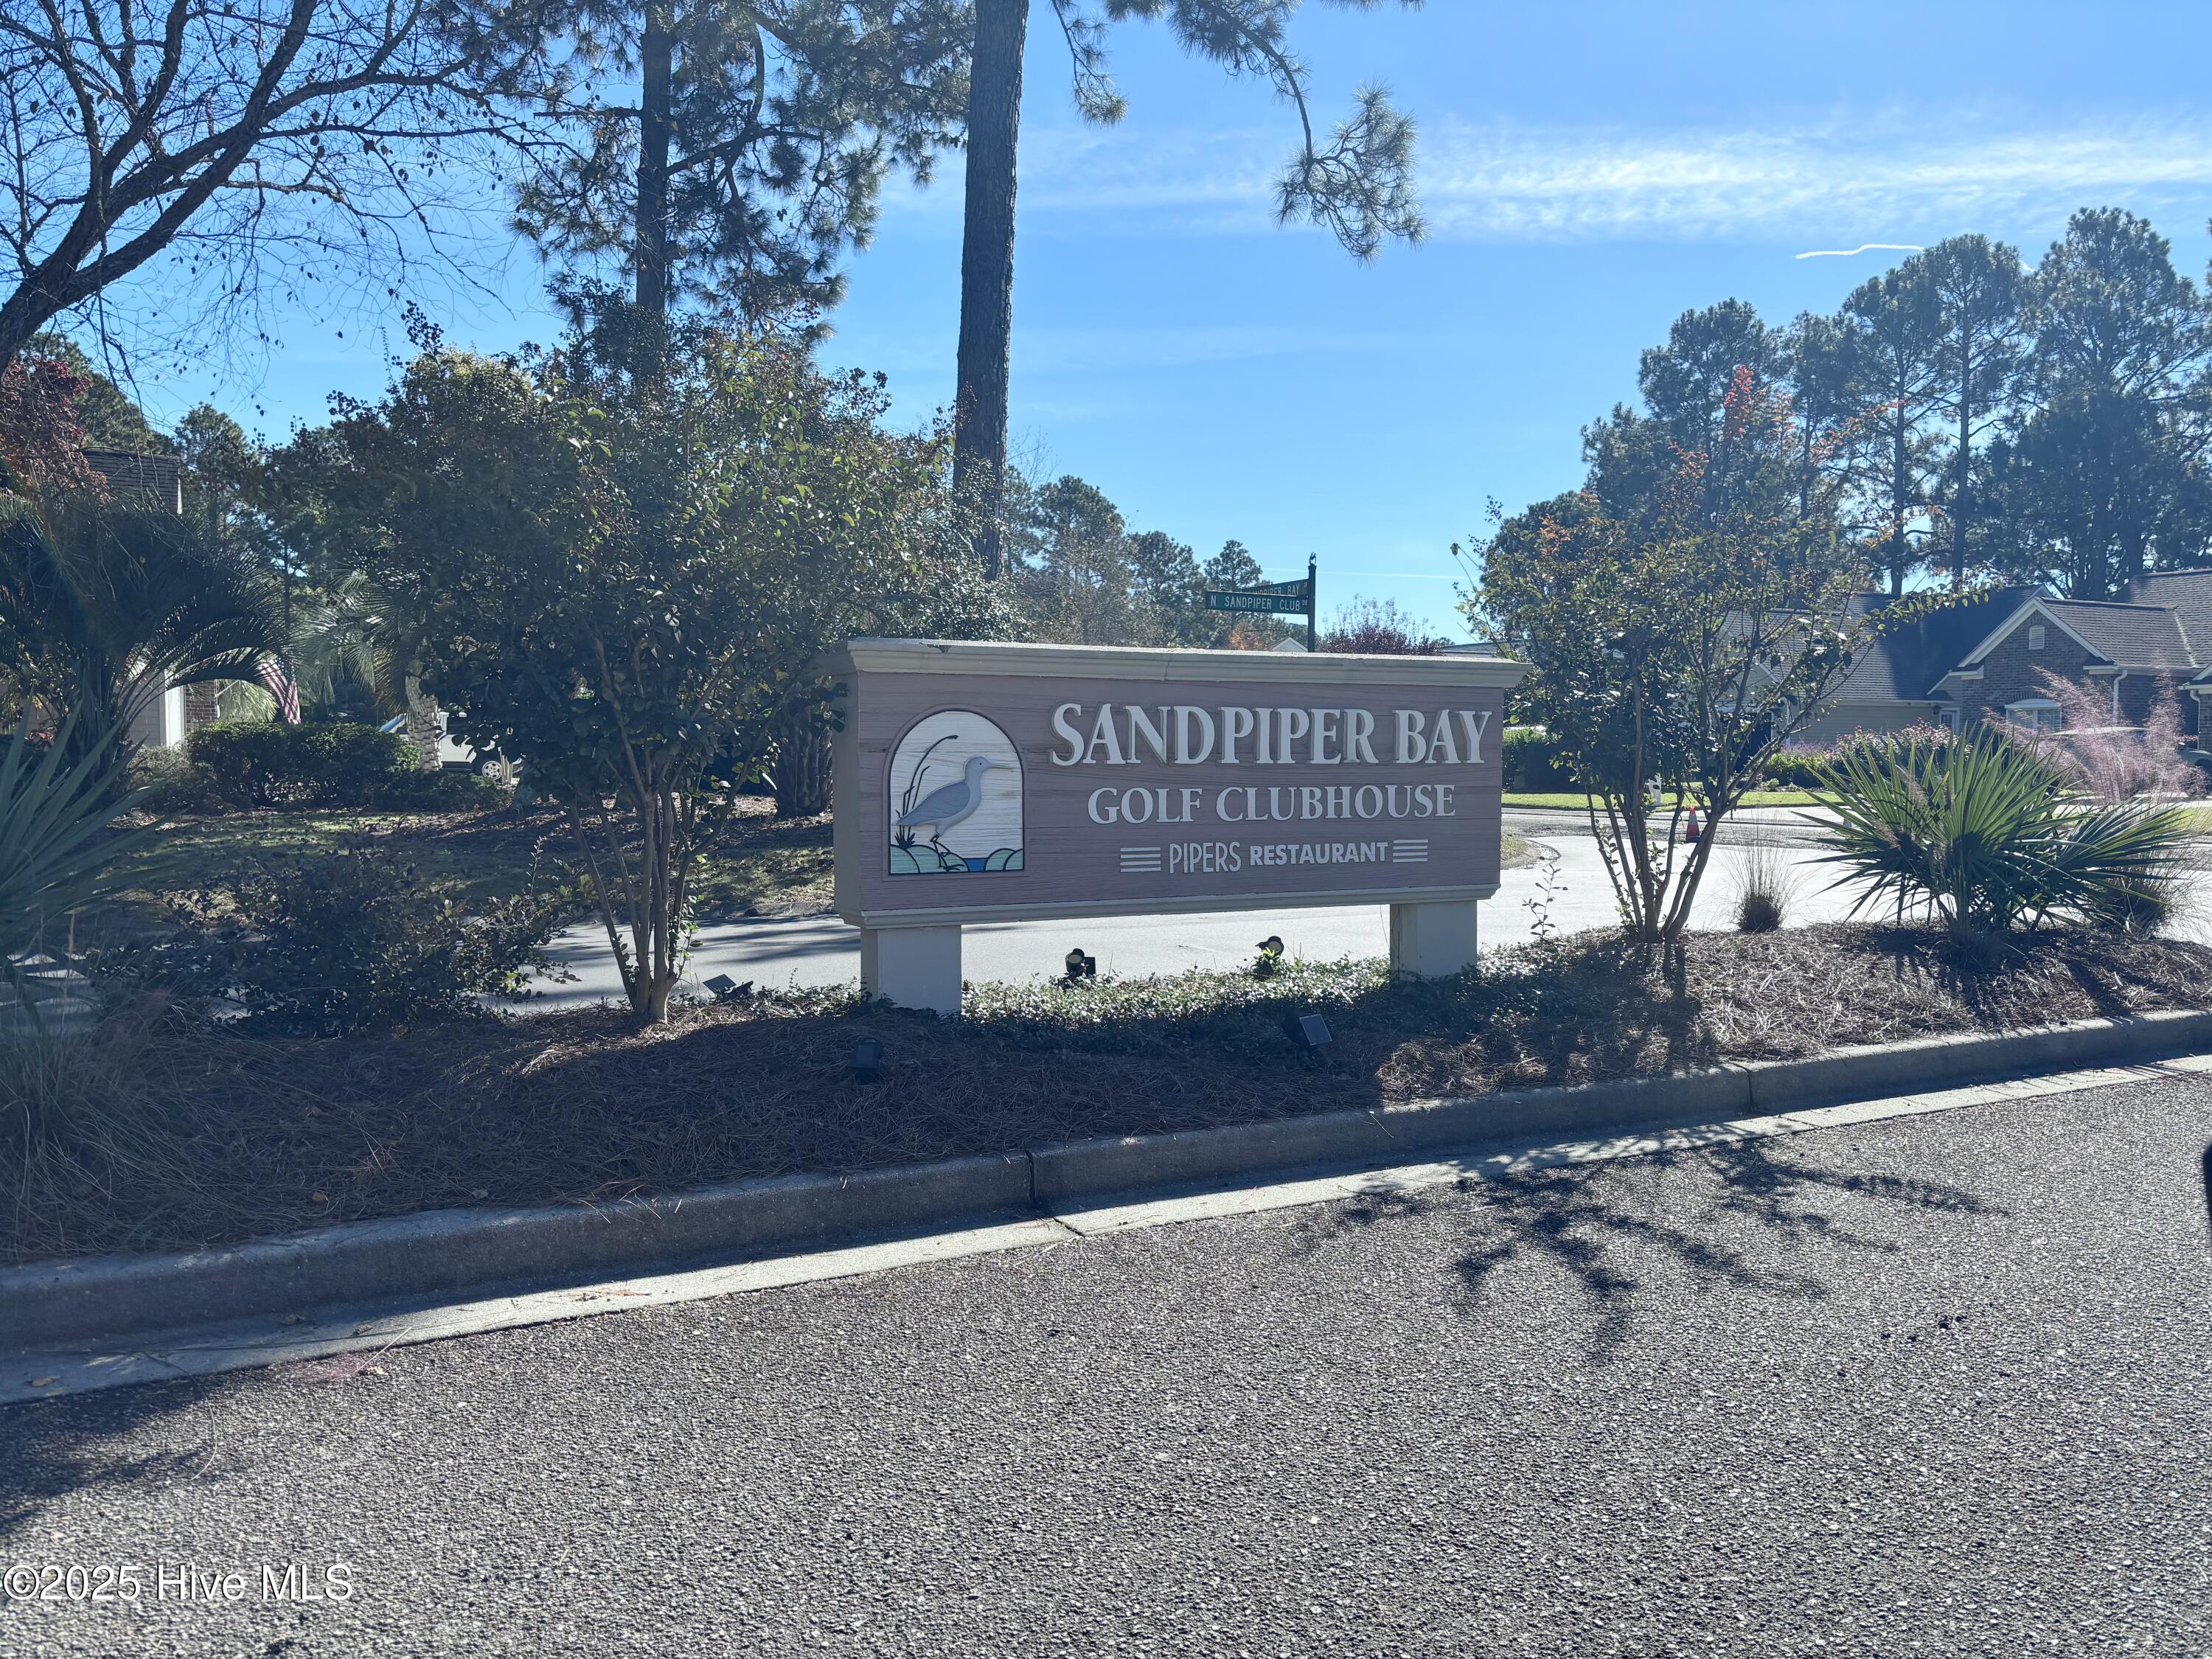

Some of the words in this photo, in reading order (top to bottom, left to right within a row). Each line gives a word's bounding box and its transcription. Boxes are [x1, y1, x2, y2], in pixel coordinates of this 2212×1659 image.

[1211, 595, 1217, 606] N
[1224, 597, 1272, 610] SANDPIPER
[1279, 599, 1301, 611] CLUB
[1287, 584, 1300, 596] BAY
[1050, 703, 1378, 766] SANDPIPER
[1391, 709, 1492, 764] BAY
[1087, 787, 1203, 824] GOLF
[1215, 784, 1455, 821] CLUBHOUSE
[1169, 841, 1242, 874] PIPERS
[1249, 841, 1388, 866] RESTAURANT
